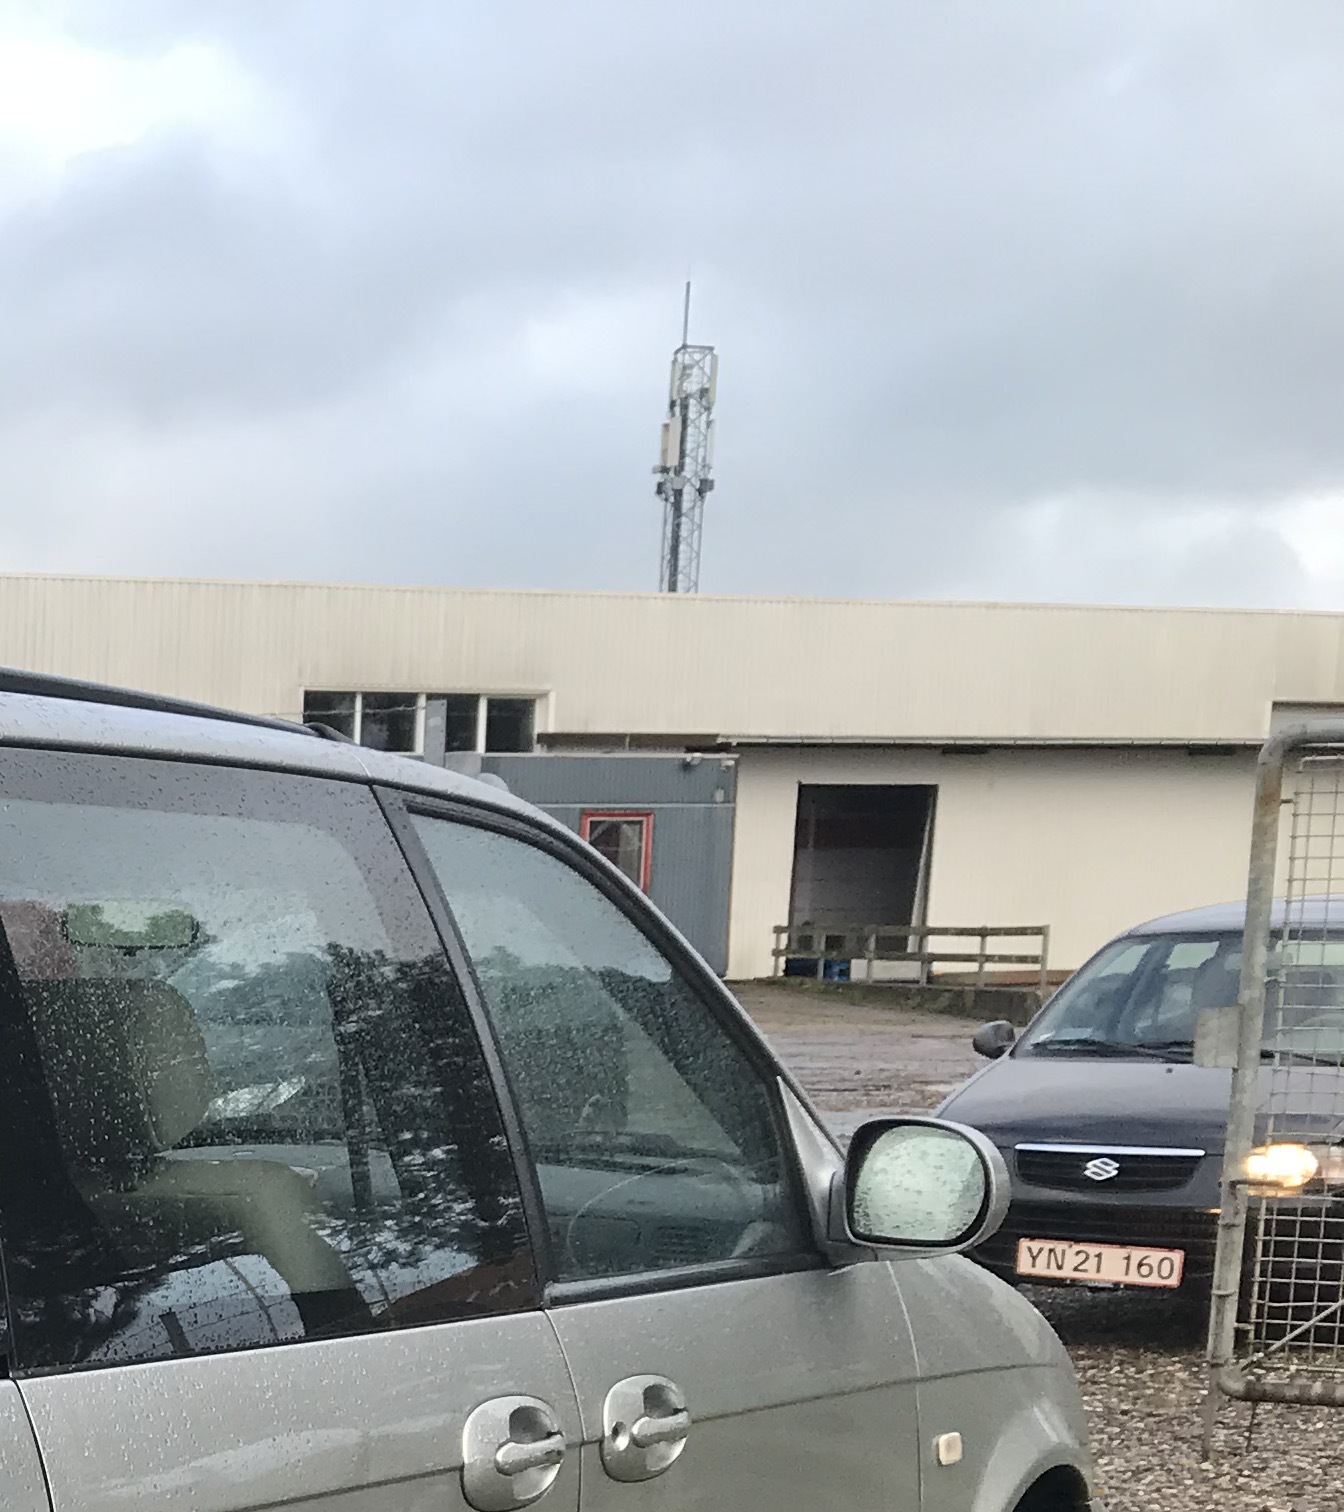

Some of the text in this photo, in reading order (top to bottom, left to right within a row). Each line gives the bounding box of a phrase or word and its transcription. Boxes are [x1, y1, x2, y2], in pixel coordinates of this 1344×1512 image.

[1026, 1245, 1175, 1280] YN 21 160
